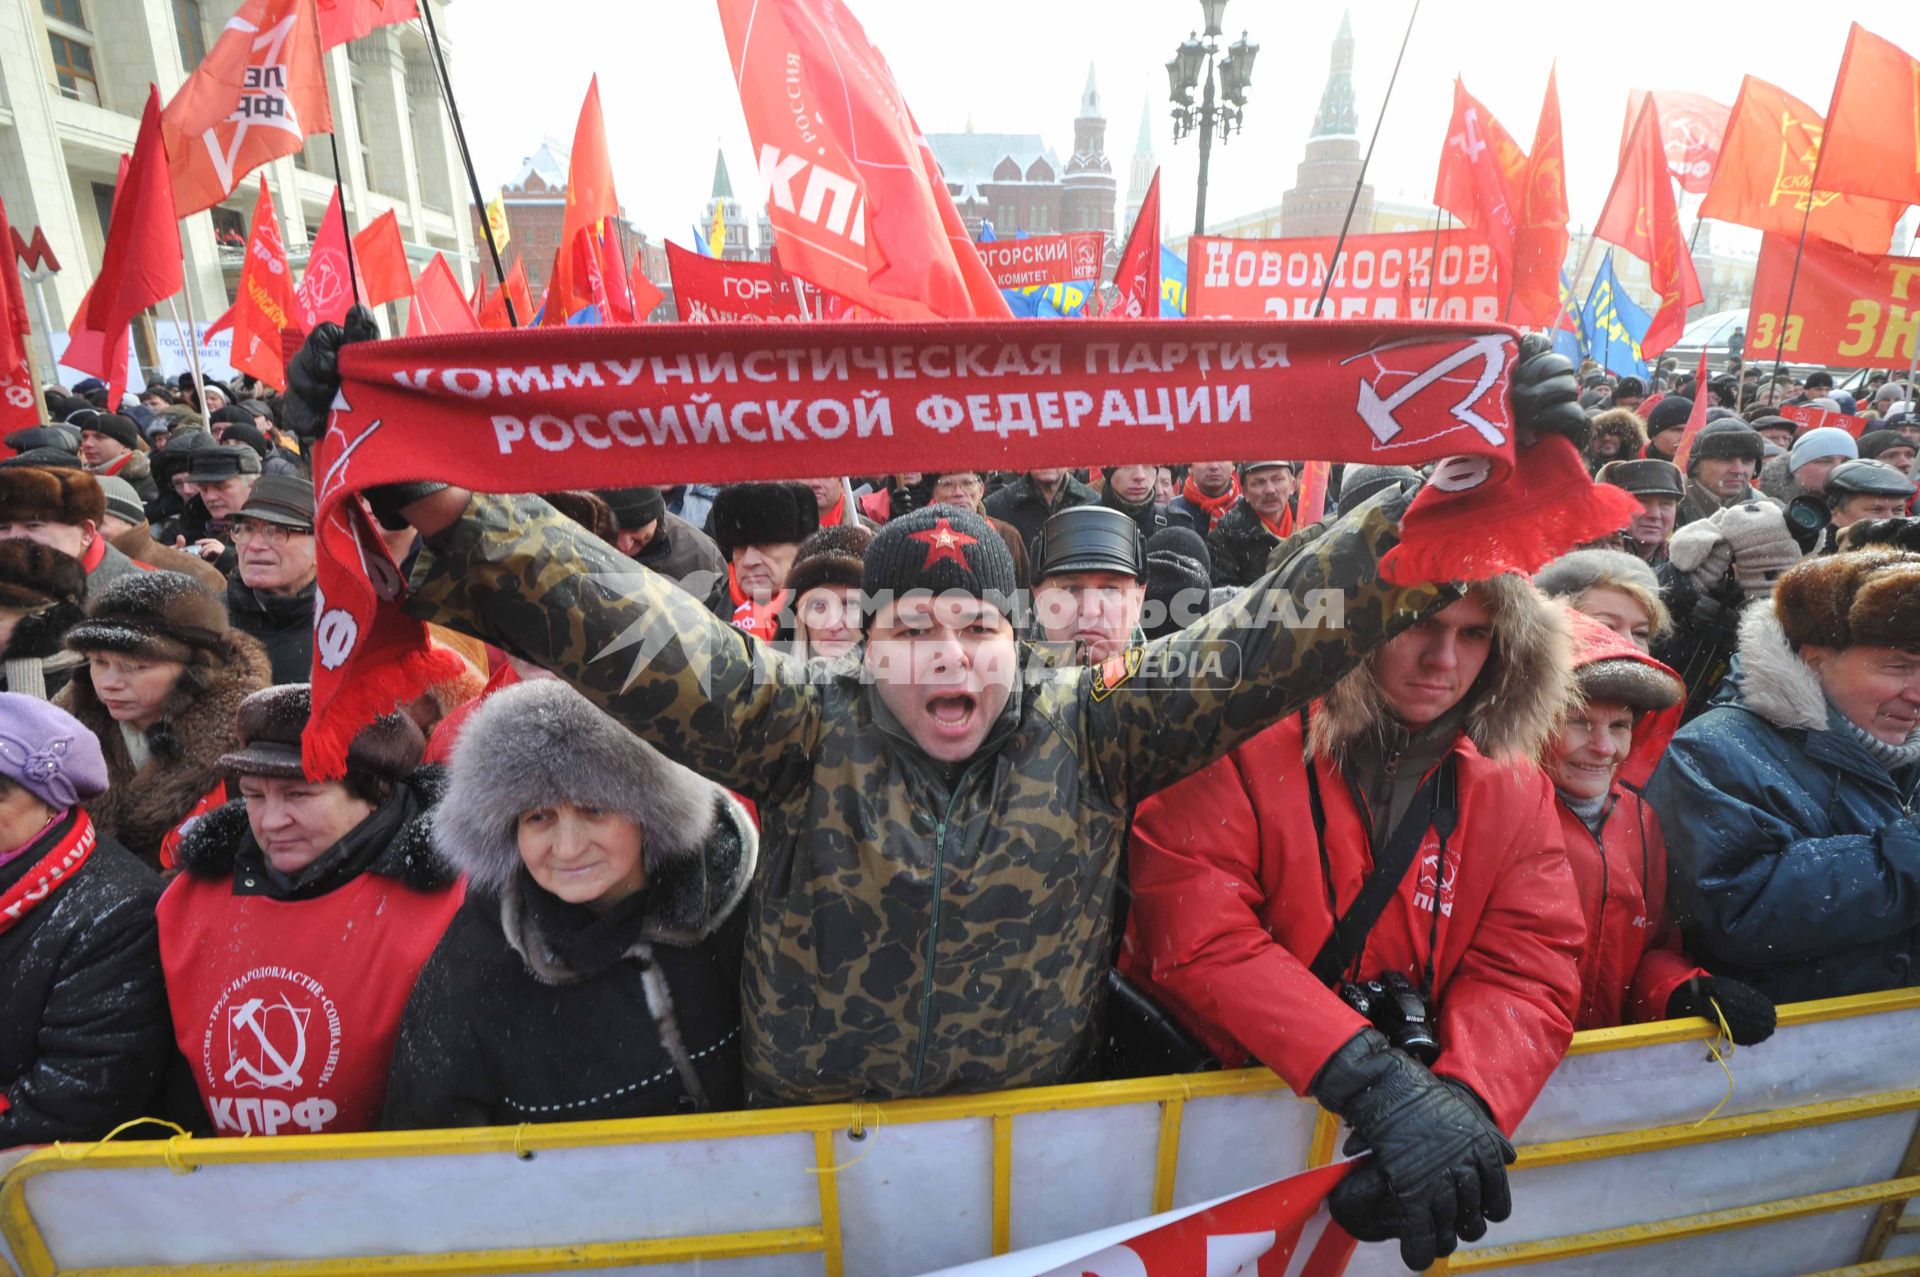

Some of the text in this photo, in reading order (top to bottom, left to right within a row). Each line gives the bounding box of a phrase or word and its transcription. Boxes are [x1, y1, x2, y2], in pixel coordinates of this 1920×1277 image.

[786, 52, 816, 143] РОССИЯ
[9, 225, 62, 272] М
[979, 240, 1068, 268] ОГОРСКИЙ
[1204, 242, 1498, 289] НОВОМОСКОВ
[722, 277, 773, 299] ГОР
[998, 269, 1048, 285] КОМИТЕТ
[1085, 342, 1291, 374] ПАРТИЯ
[490, 384, 1252, 455] РОССИЙСКОЙ ФЕДЕРАЦИИ
[203, 966, 342, 1085] РОССИЯ ТРУД НАРОДОВЛАСТИЕ СОЦИАЛИЗМ
[1405, 1014, 1425, 1023] Nikon
[209, 1095, 337, 1136] КПРФ
